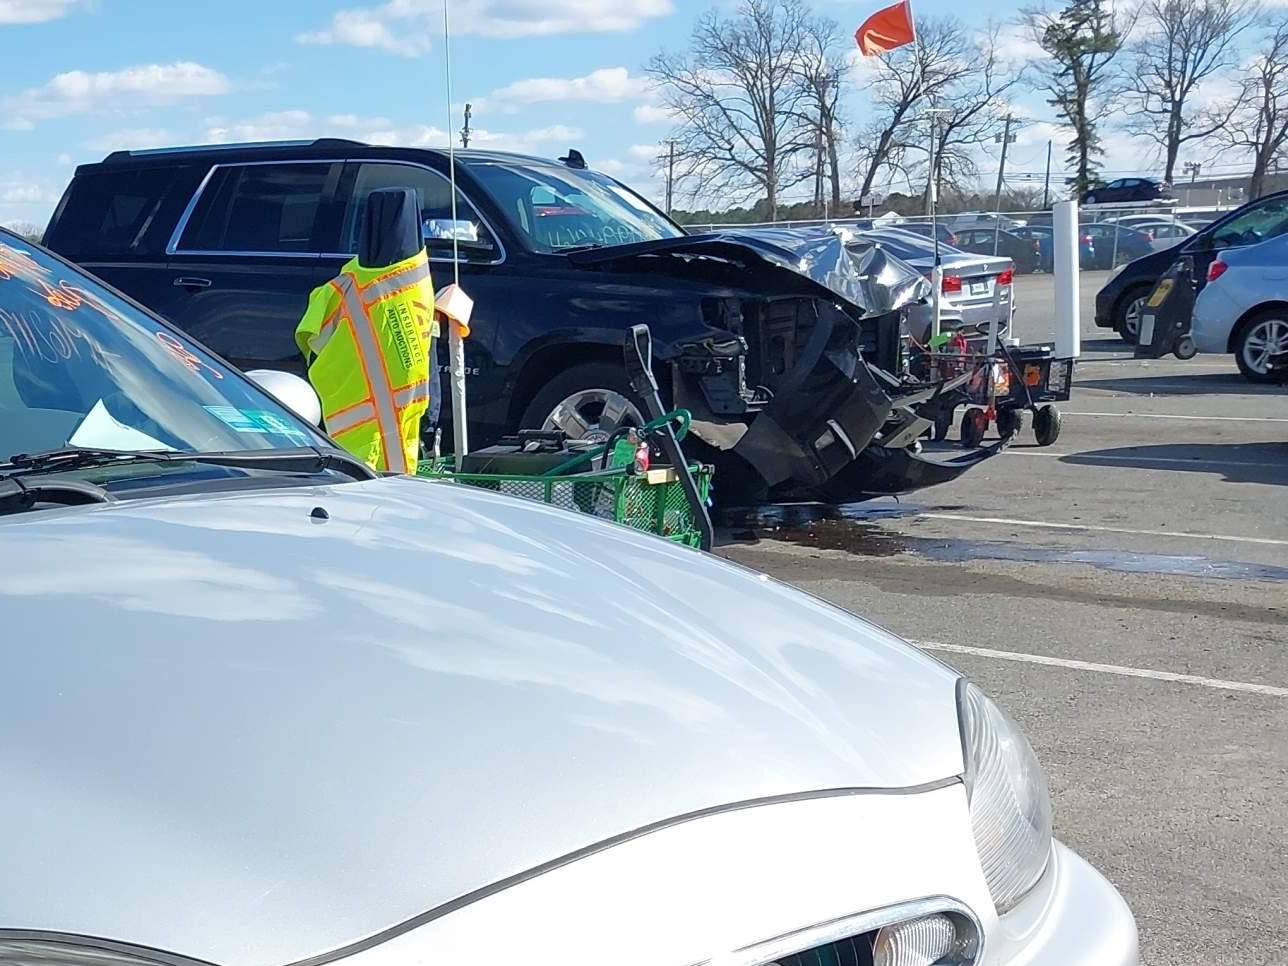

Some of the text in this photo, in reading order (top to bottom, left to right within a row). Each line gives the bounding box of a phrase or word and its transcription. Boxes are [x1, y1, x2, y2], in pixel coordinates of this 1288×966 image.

[387, 308, 413, 370] AUTO AUCTIONS
[398, 303, 423, 365] INSURANCE
[437, 365, 480, 376] TAOE
